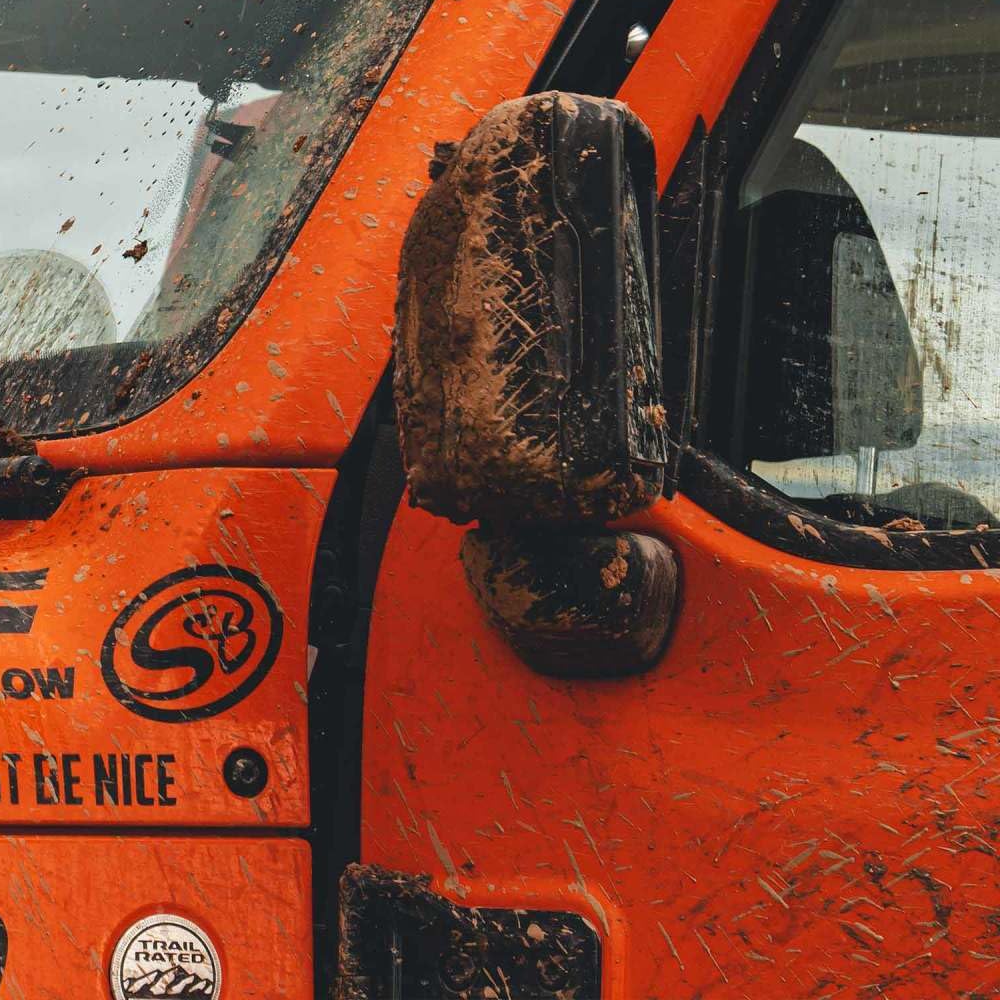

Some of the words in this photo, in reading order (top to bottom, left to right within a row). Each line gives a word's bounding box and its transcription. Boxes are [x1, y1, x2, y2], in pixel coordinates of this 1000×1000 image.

[93, 753, 178, 807] NICE
[138, 939, 201, 952] TRAIL
[134, 951, 205, 964] RATED
